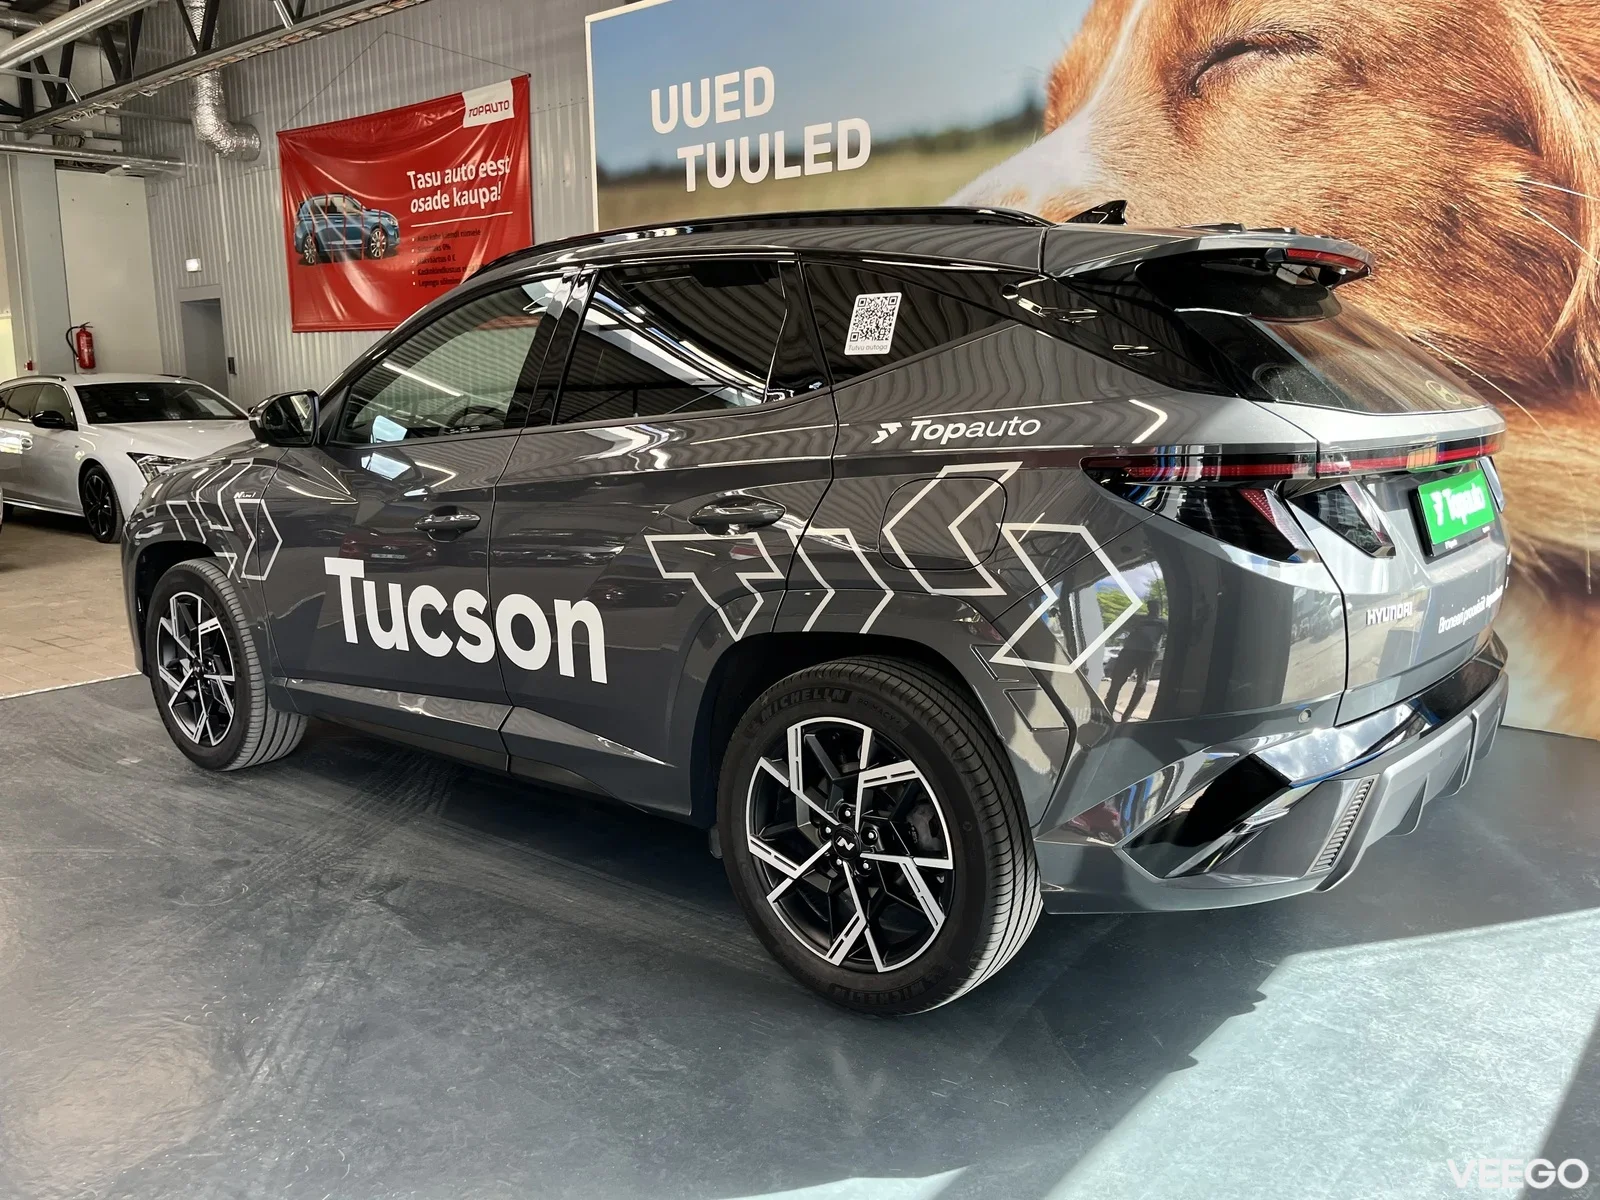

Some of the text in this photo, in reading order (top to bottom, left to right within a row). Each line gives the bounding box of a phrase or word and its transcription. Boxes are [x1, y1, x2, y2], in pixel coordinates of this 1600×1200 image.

[468, 100, 510, 118] TOPAUTO
[651, 66, 775, 134] UUED
[677, 117, 871, 192] TUULED
[406, 155, 511, 190] Tasu auto eest
[410, 181, 502, 213] osade kaupa!
[865, 344, 888, 352] autoga
[910, 416, 1042, 445] Topauto
[323, 556, 609, 685] Tucson
[1366, 601, 1413, 626] HYUNDAI
[760, 686, 846, 723] MICHELIN
